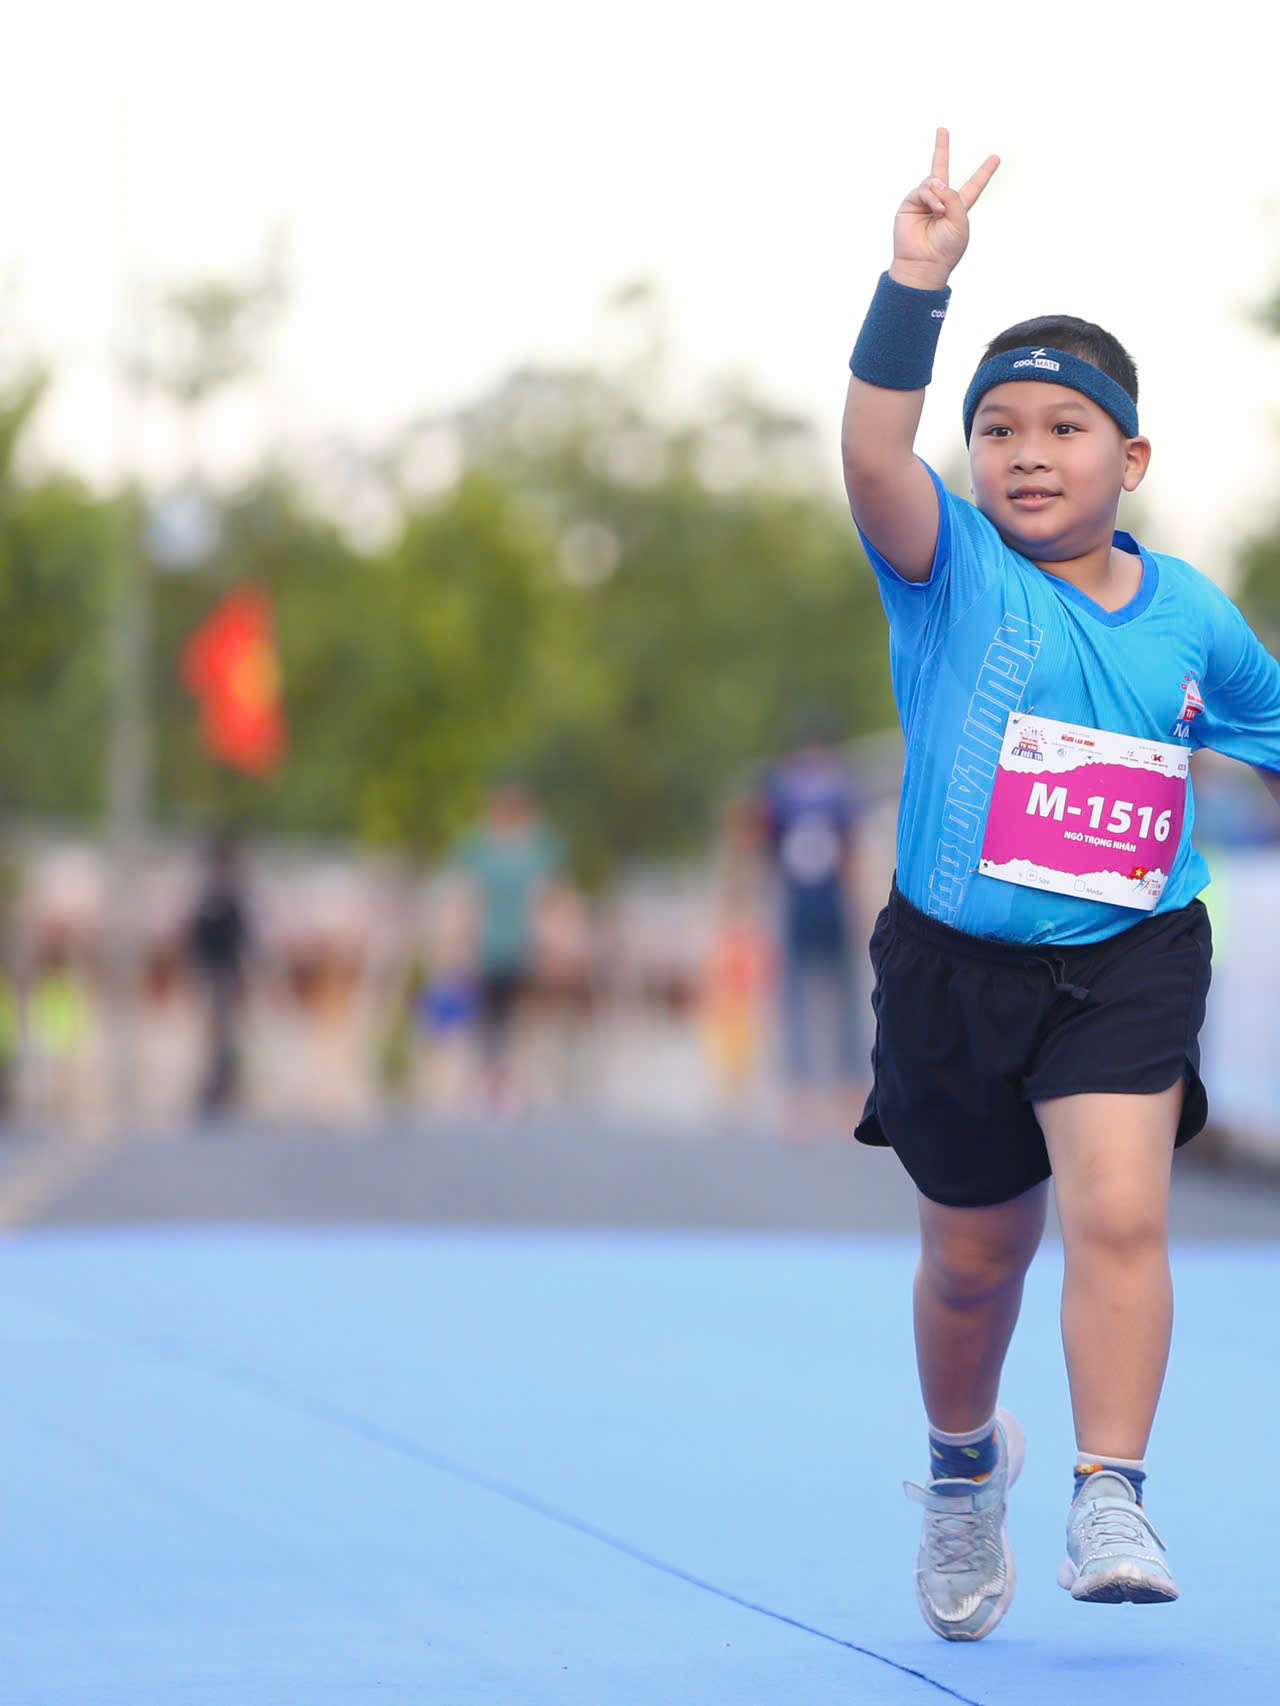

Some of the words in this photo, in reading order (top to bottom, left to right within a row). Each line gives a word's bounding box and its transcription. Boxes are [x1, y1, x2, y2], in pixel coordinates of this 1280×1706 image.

[1025, 781, 1173, 843] M-1516
[1064, 831, 1083, 842] NGÔ
[1084, 834, 1112, 848] TRỌNG
